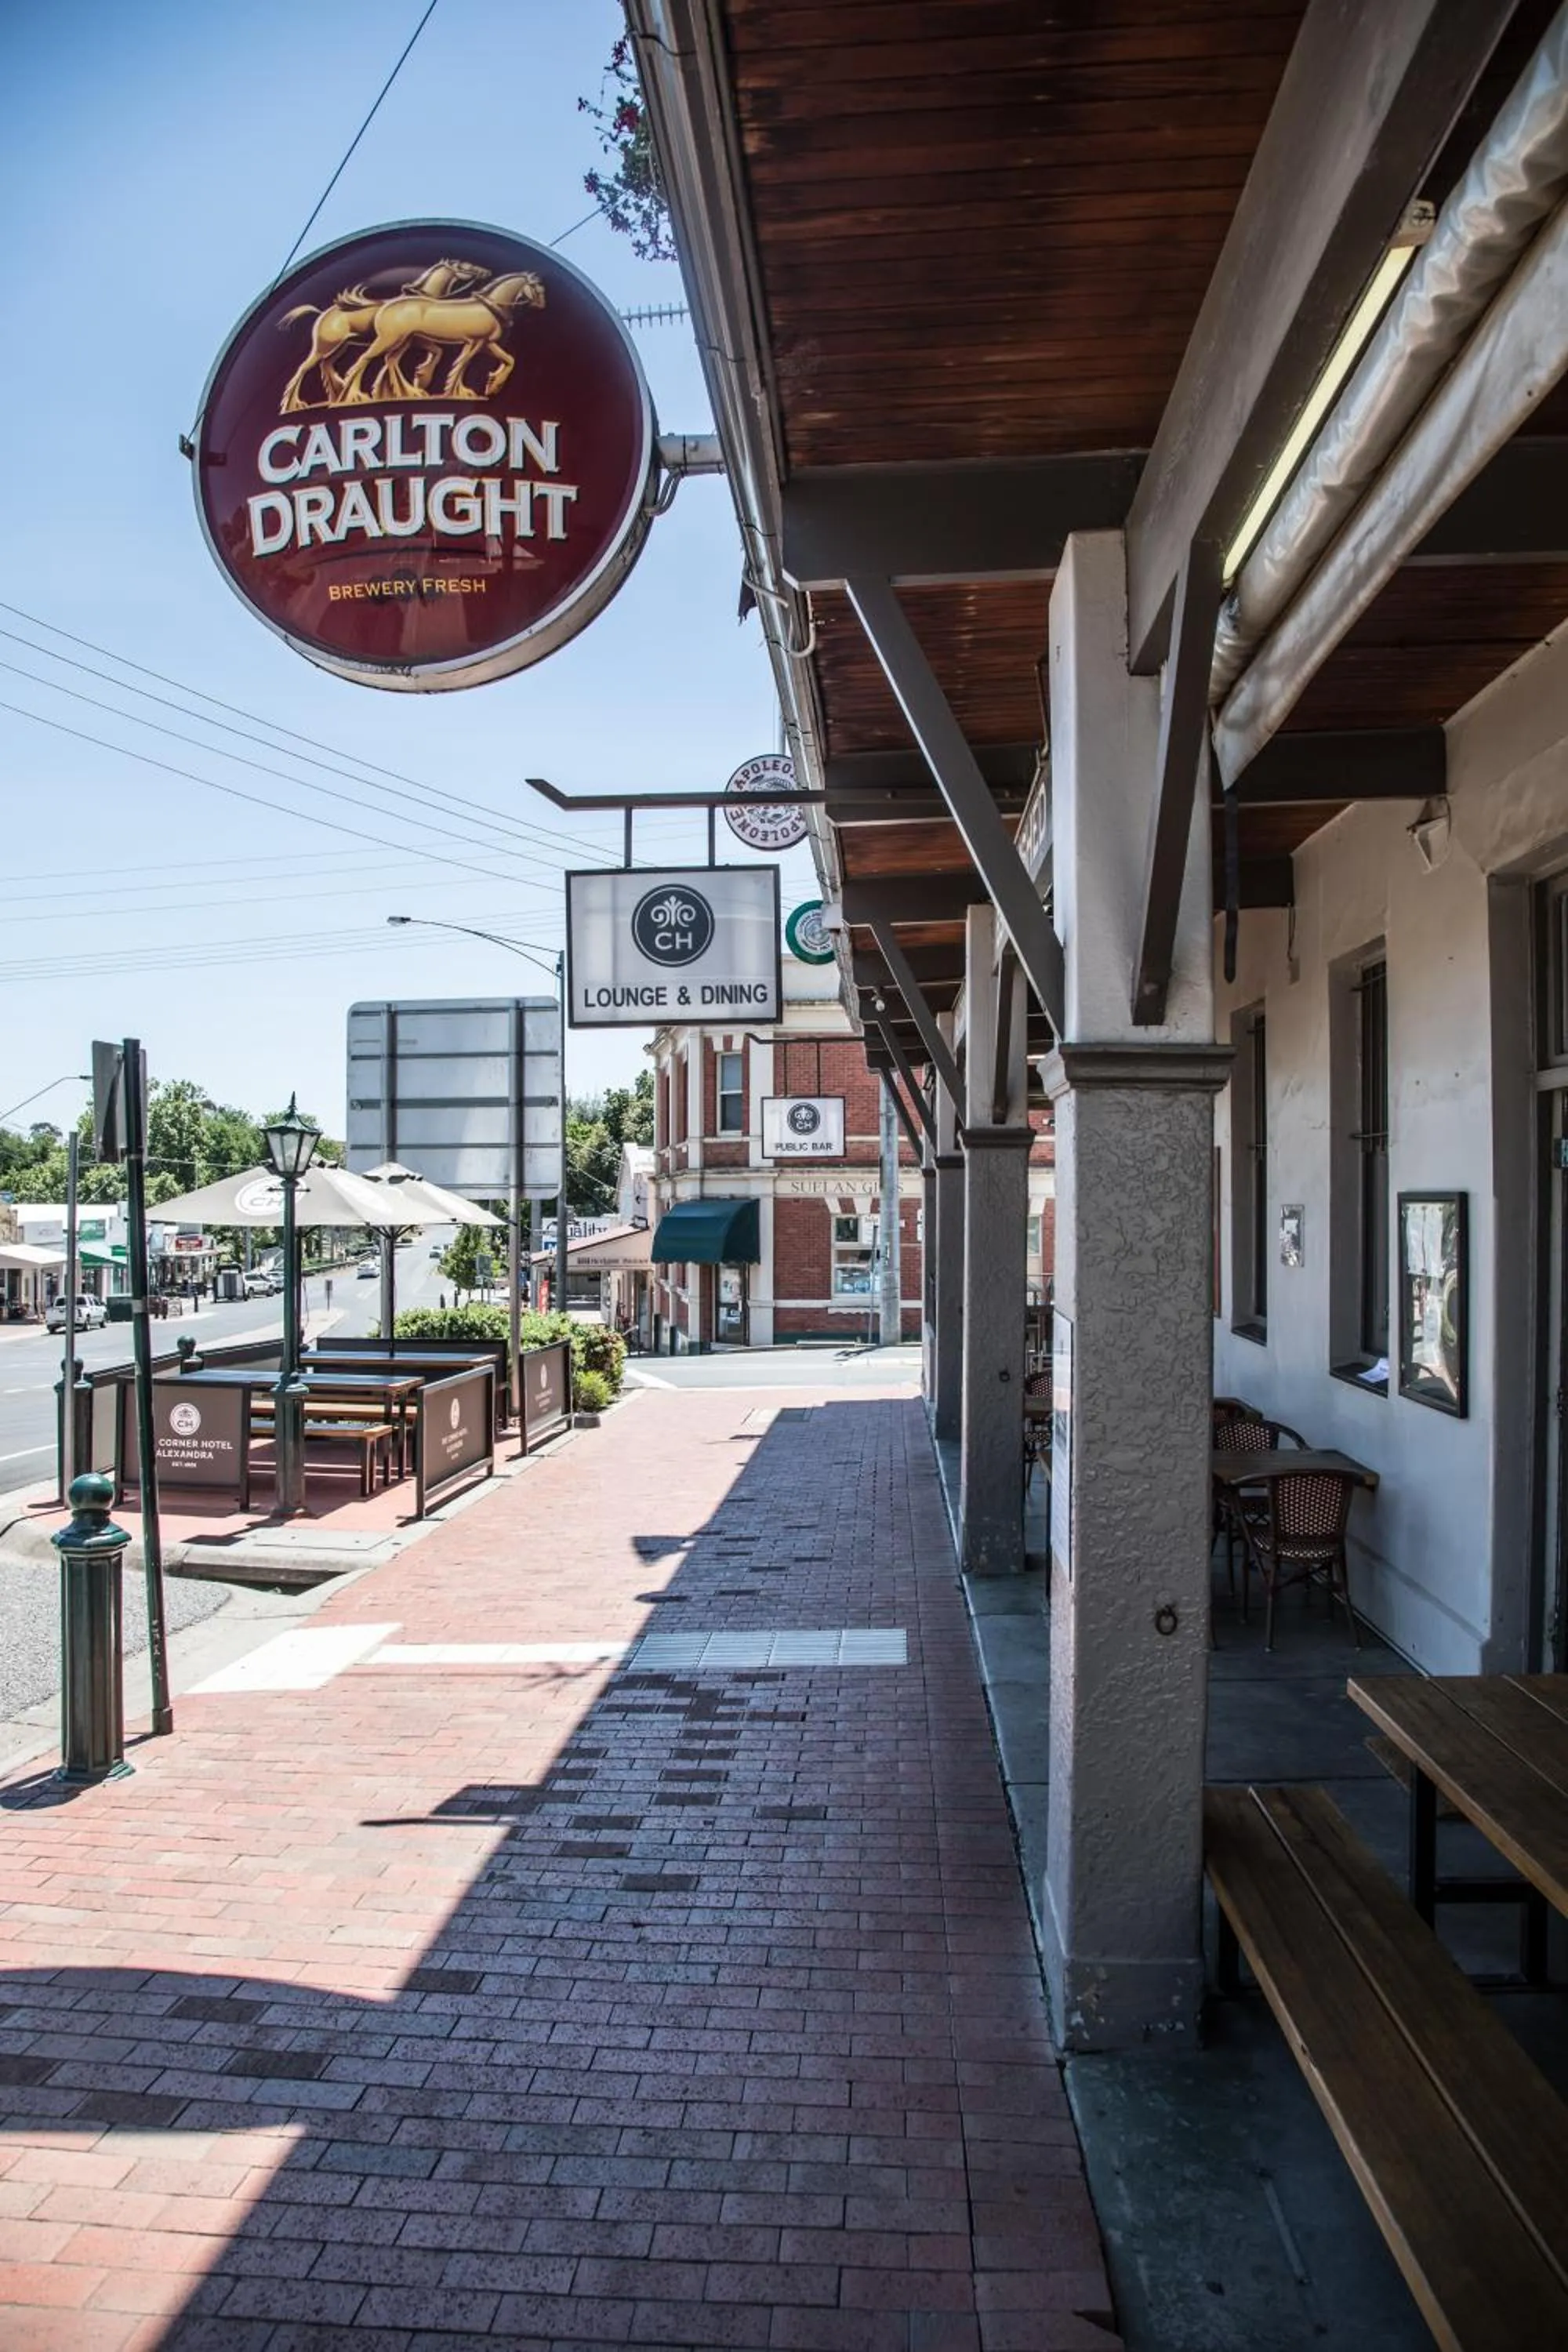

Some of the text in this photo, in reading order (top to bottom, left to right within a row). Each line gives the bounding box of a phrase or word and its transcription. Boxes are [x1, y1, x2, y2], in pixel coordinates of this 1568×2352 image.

[257, 413, 562, 484] CARLTON
[247, 477, 579, 557] DRAUGHT
[329, 578, 486, 601] BREWERY FRESH
[735, 759, 792, 791] APOLEO
[729, 806, 805, 842] APOLEONE
[655, 931, 693, 950] CH
[584, 983, 768, 1007] LOUNGE & DINING
[796, 1120, 812, 1130] CH
[775, 1142, 834, 1152] PUBLIC BAR
[862, 1181, 903, 1193] GIS
[156, 1449, 214, 1460] ALEXANDRA
[159, 1439, 234, 1450] CORNER HOTEL
